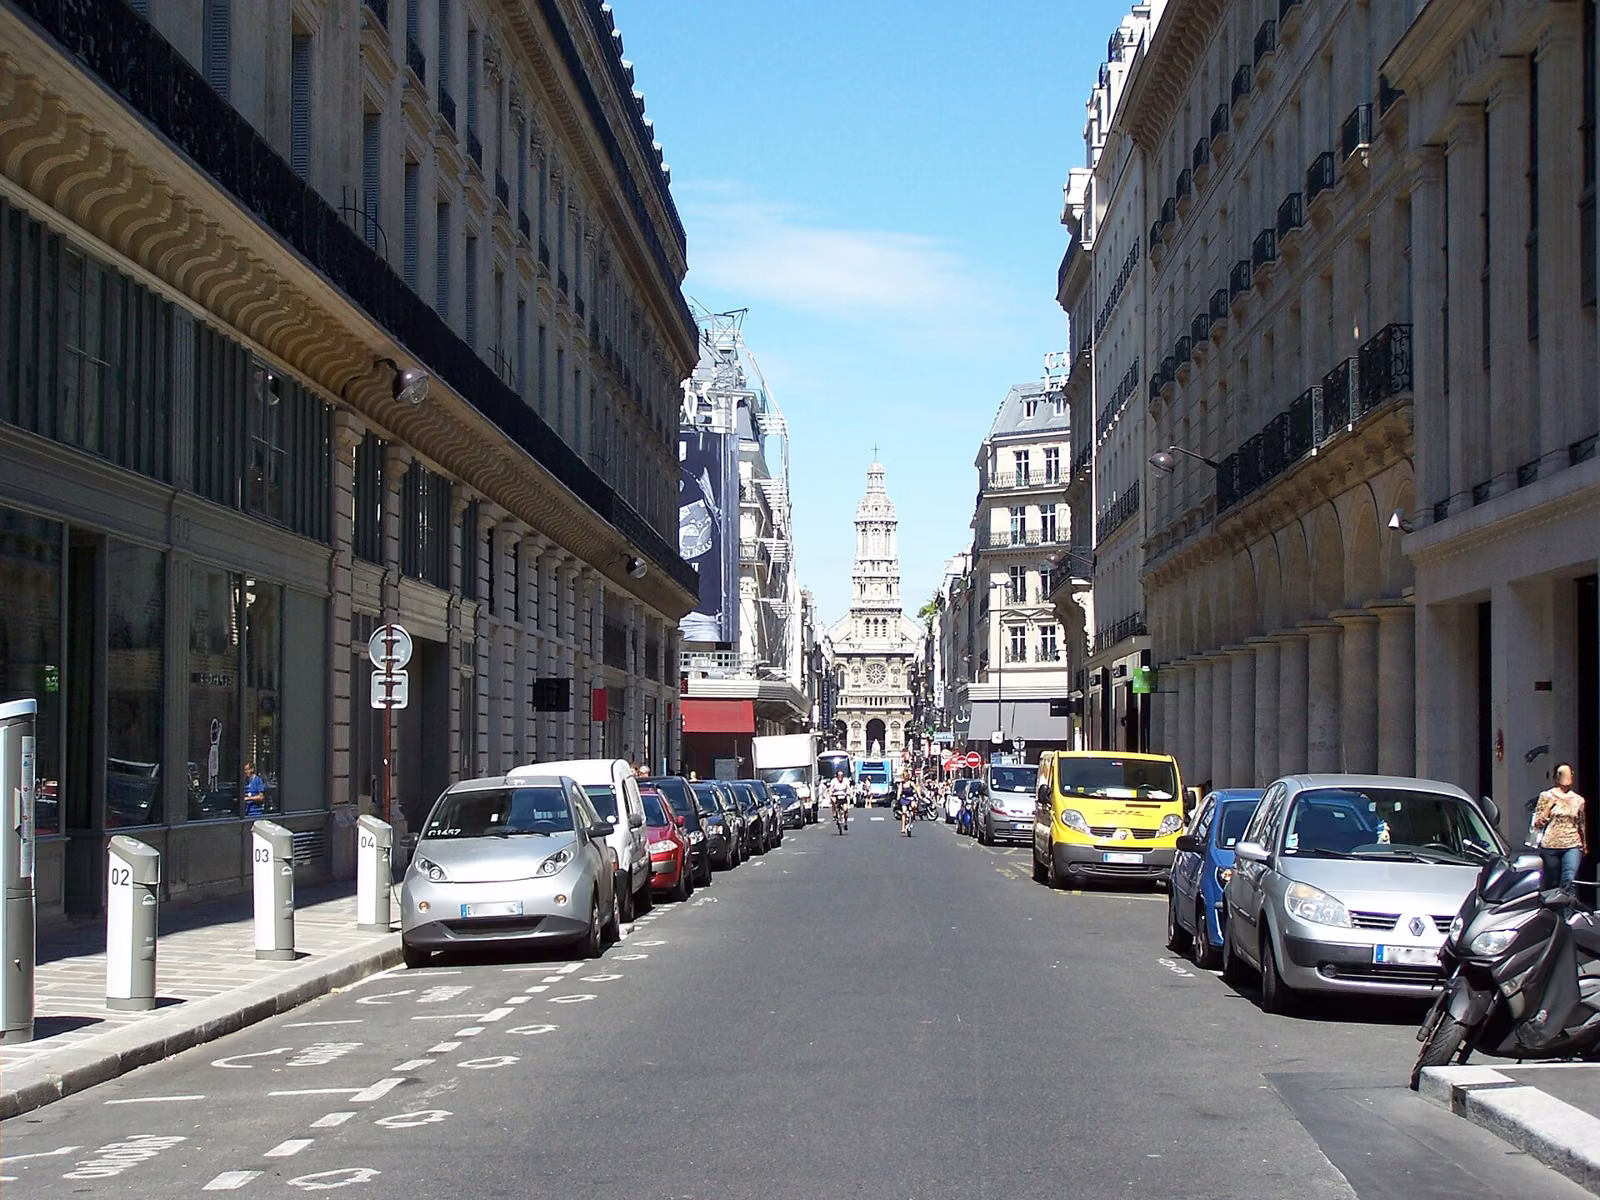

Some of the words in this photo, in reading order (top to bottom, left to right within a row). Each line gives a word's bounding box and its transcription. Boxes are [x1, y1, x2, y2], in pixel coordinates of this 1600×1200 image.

[360, 836, 374, 849] 04
[254, 848, 269, 863] 03
[111, 867, 130, 887] 02
